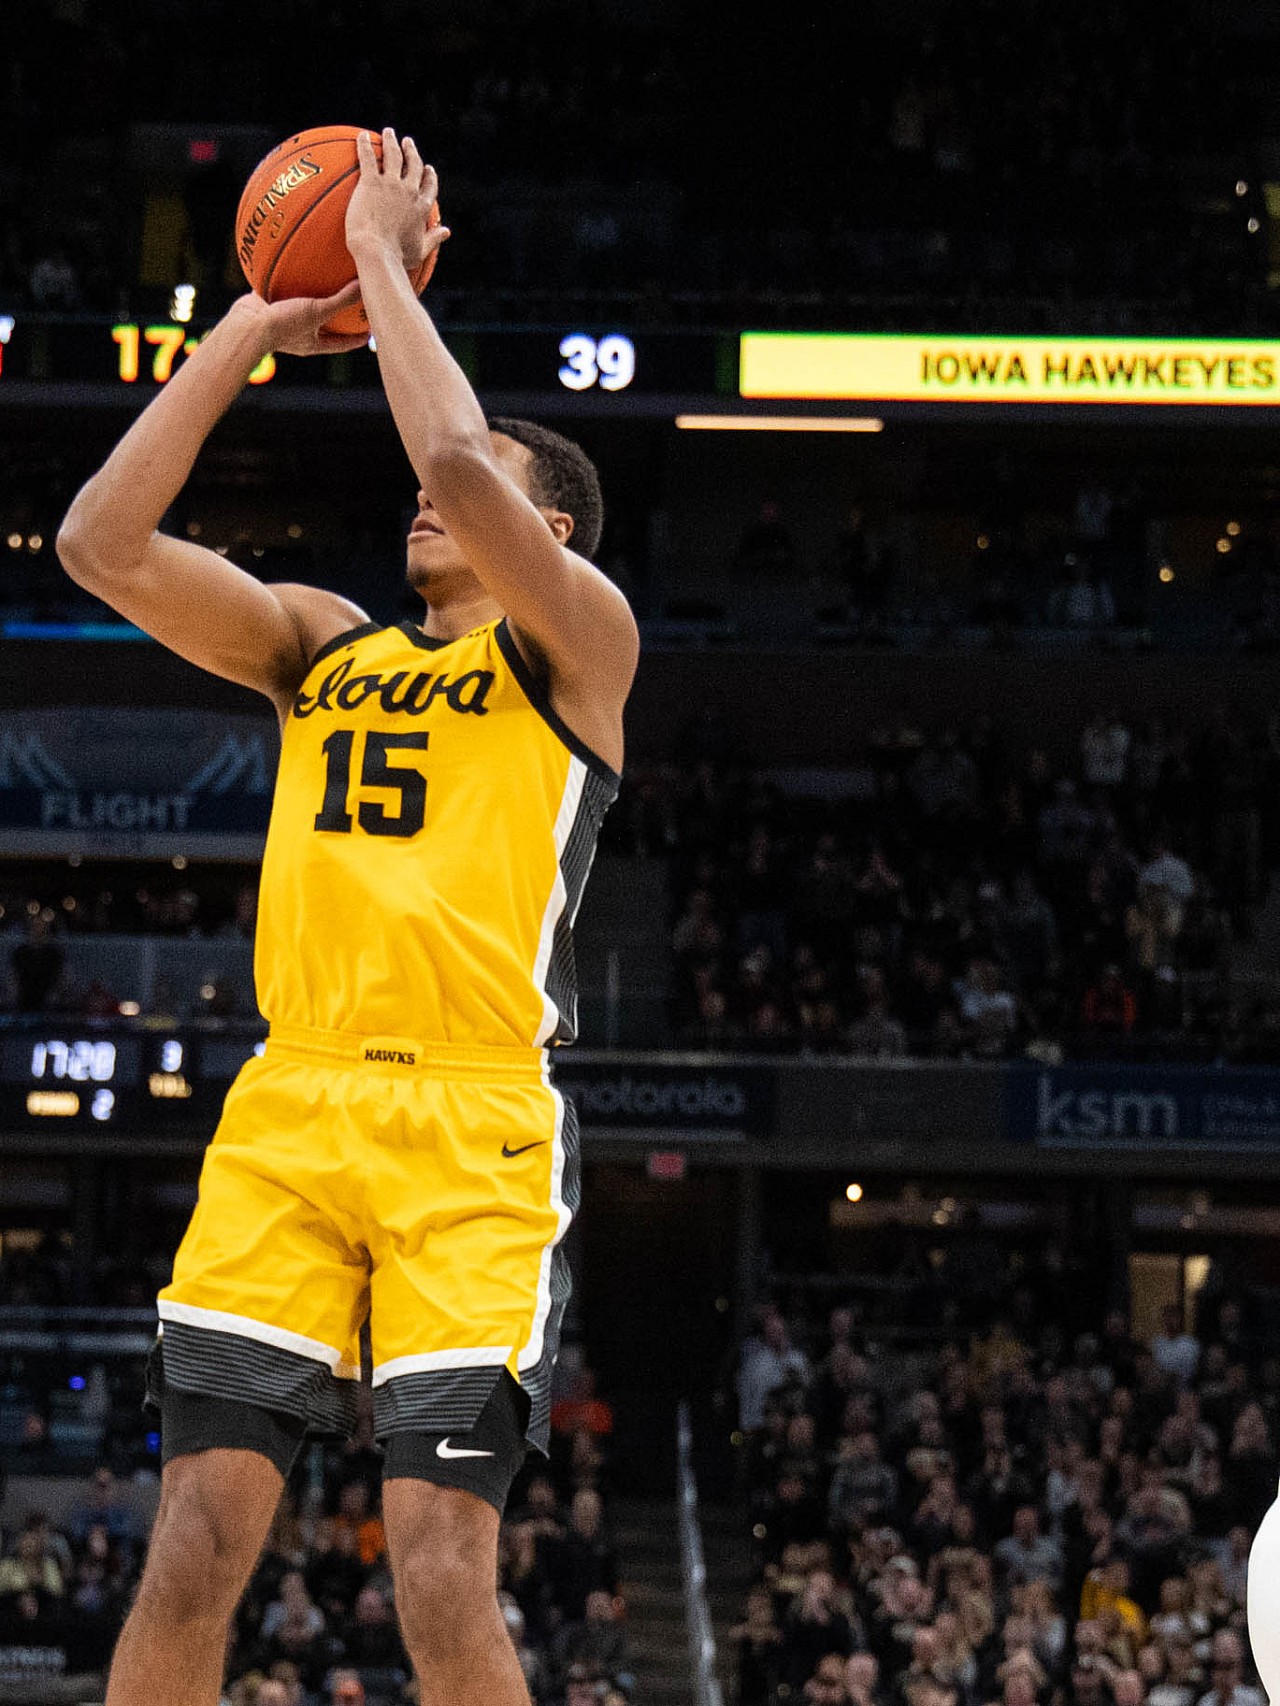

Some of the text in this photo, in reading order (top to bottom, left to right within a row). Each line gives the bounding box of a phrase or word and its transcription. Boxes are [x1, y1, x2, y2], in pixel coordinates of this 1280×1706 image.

[240, 152, 323, 266] SPALDING
[558, 334, 636, 392] 39
[920, 351, 1276, 389] IOWA HAWKEYES
[41, 792, 194, 829] FLIGHT
[314, 729, 430, 838] 15
[365, 1048, 416, 1065] HAWKS
[1037, 1072, 1178, 1134] ksm
